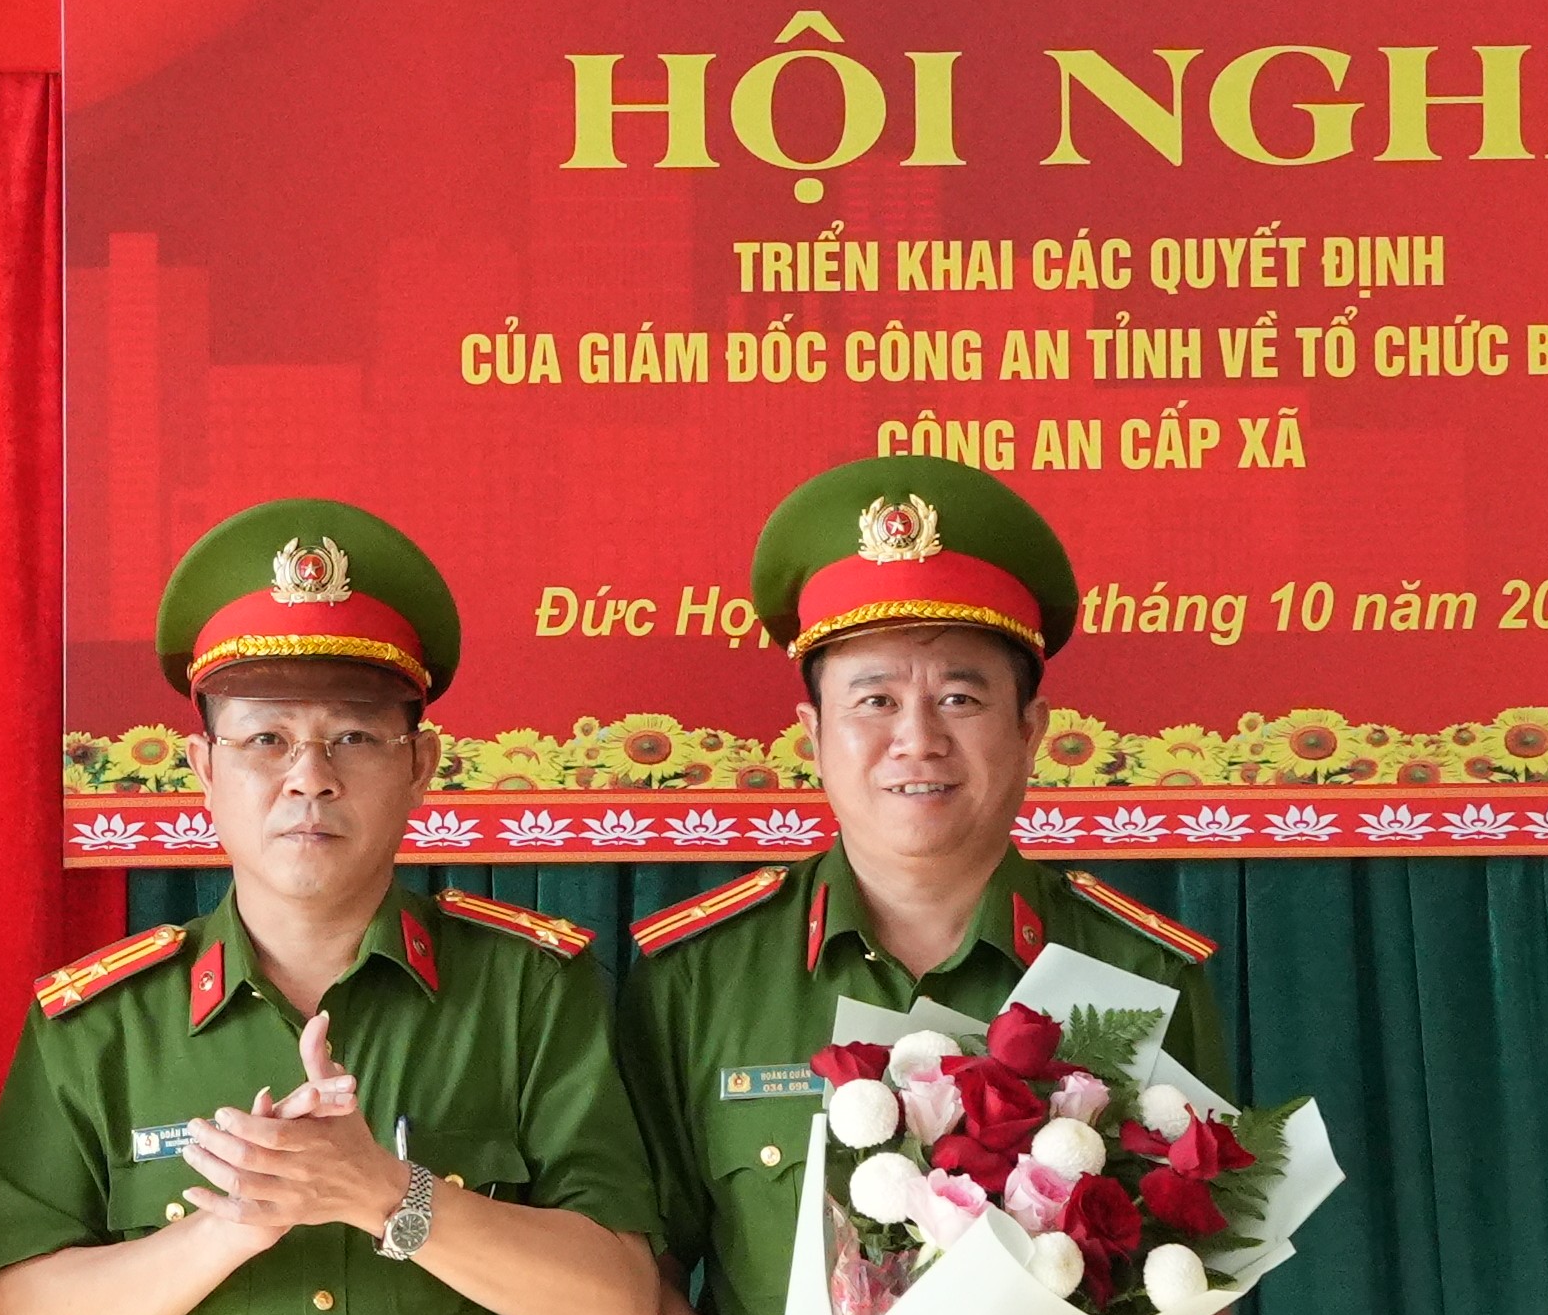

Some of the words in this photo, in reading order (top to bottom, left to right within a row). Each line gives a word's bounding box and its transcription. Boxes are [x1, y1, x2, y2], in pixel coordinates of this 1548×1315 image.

[559, 10, 967, 205] HỘI
[733, 220, 879, 293] TRIỂN
[897, 239, 1014, 292] KHAI
[1032, 228, 1132, 291] CÁC
[1150, 220, 1307, 295] QUYẾT
[1320, 235, 1445, 299] ĐỊNH
[460, 316, 563, 386] CỦA
[578, 321, 709, 384] GIÁM
[724, 313, 827, 384] ĐỐC
[844, 319, 983, 383] CÔNG
[999, 329, 1070, 381] AN
[1085, 310, 1202, 380] TỈNH
[1218, 310, 1279, 379] VỀ
[1294, 305, 1359, 378] TỔ
[1373, 314, 1509, 378] CHỨC
[877, 409, 1015, 471] CÔNG
[1031, 419, 1102, 471] AN
[1120, 400, 1221, 470] CẤP
[1238, 407, 1307, 469] XÃ
[534, 585, 657, 637] Đức
[675, 586, 772, 649] Hợ
[1081, 581, 1248, 646] tháng
[1269, 581, 1335, 632] 10
[1352, 579, 1478, 632] năm
